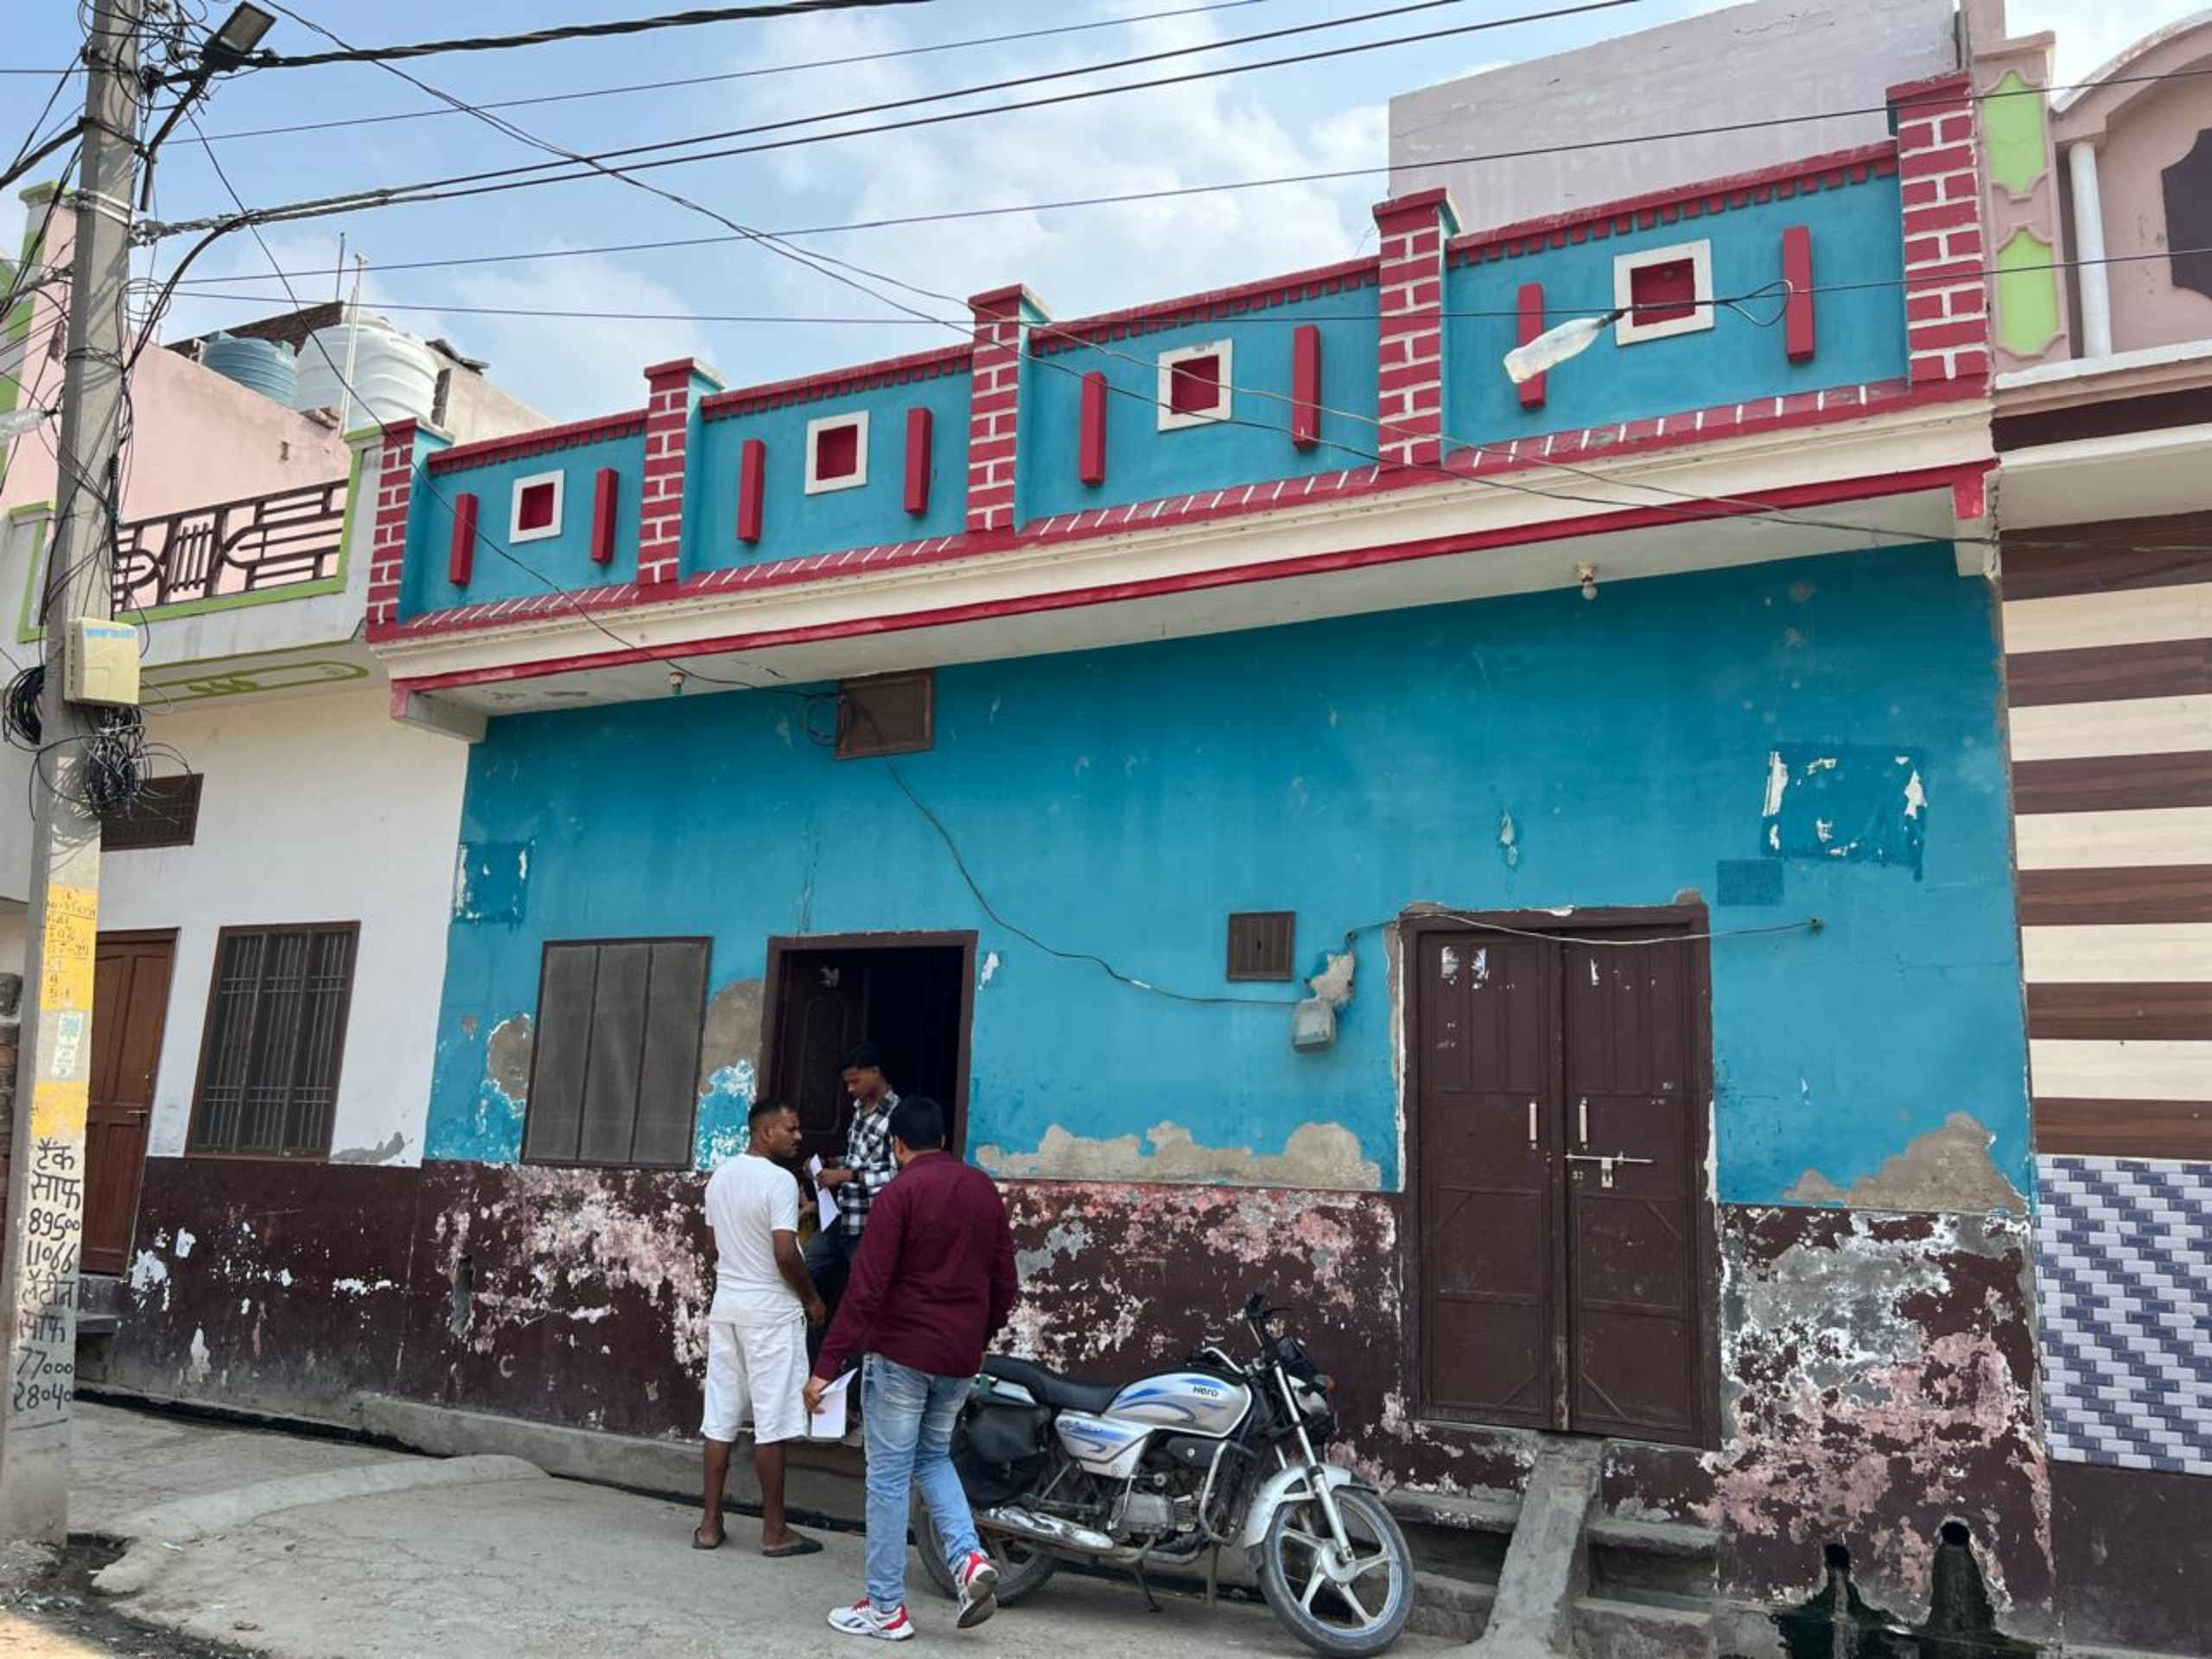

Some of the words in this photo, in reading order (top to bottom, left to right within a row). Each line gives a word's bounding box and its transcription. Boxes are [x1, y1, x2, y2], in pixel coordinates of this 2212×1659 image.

[29, 1207, 80, 1241] 89500
[27, 1240, 77, 1274] 11066
[16, 1345, 73, 1381] 77000
